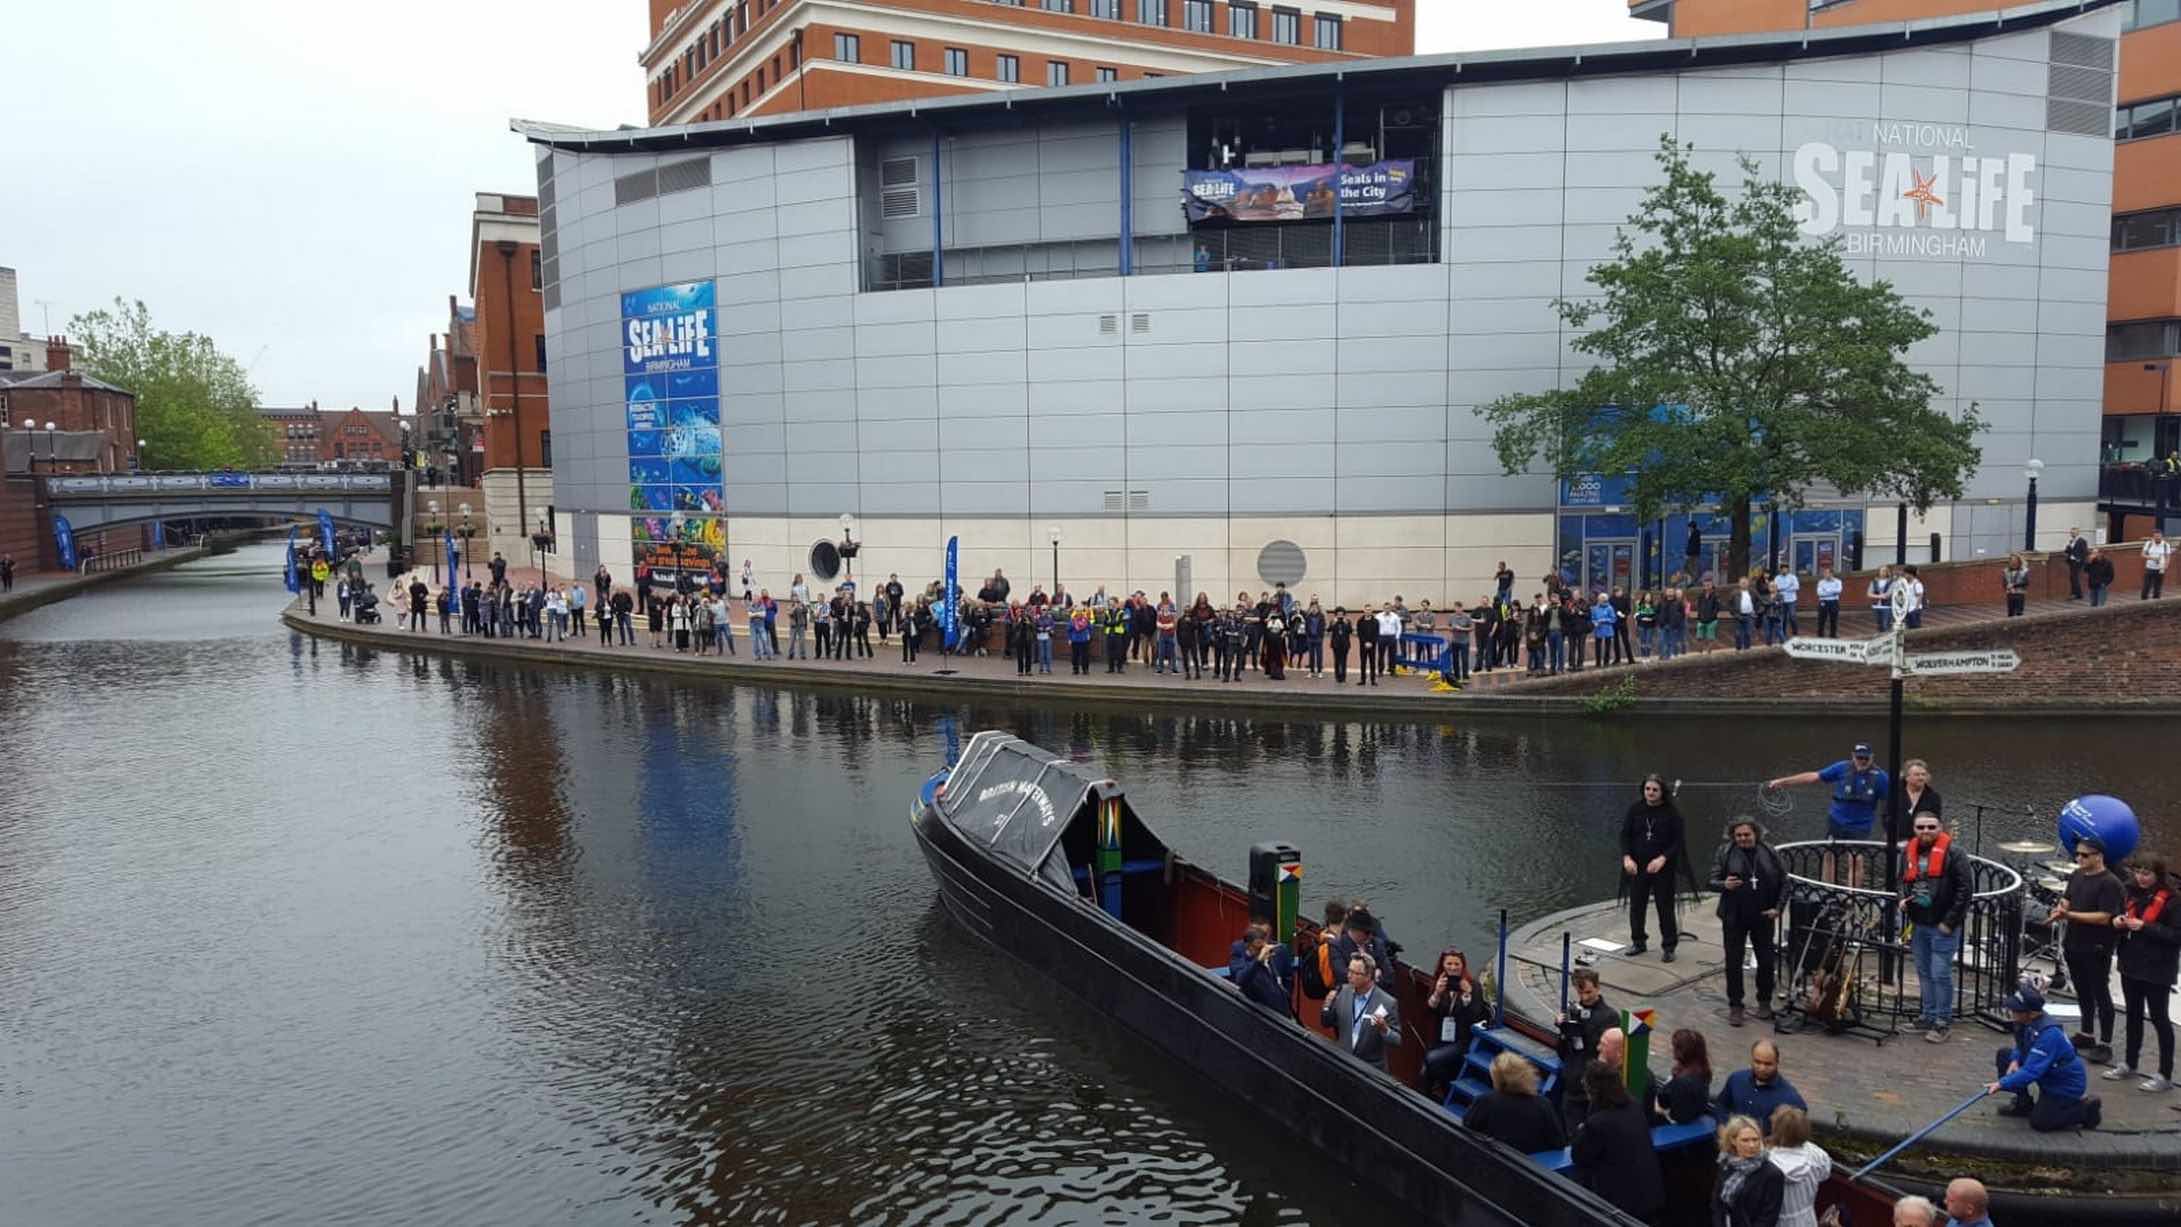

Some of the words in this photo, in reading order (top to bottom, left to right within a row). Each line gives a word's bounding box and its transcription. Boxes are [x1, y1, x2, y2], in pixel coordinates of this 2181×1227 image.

[1873, 124, 1974, 149] NATIONAL
[1374, 172, 1386, 183] in
[1340, 187, 1360, 198] the
[1362, 185, 1386, 199] City
[1848, 234, 1986, 257] BIRMINGHAM
[645, 356, 692, 372] BIRMINGHAM
[1791, 643, 1847, 655] WORCESTER
[1916, 656, 1989, 668] WOLVERHAMPTON
